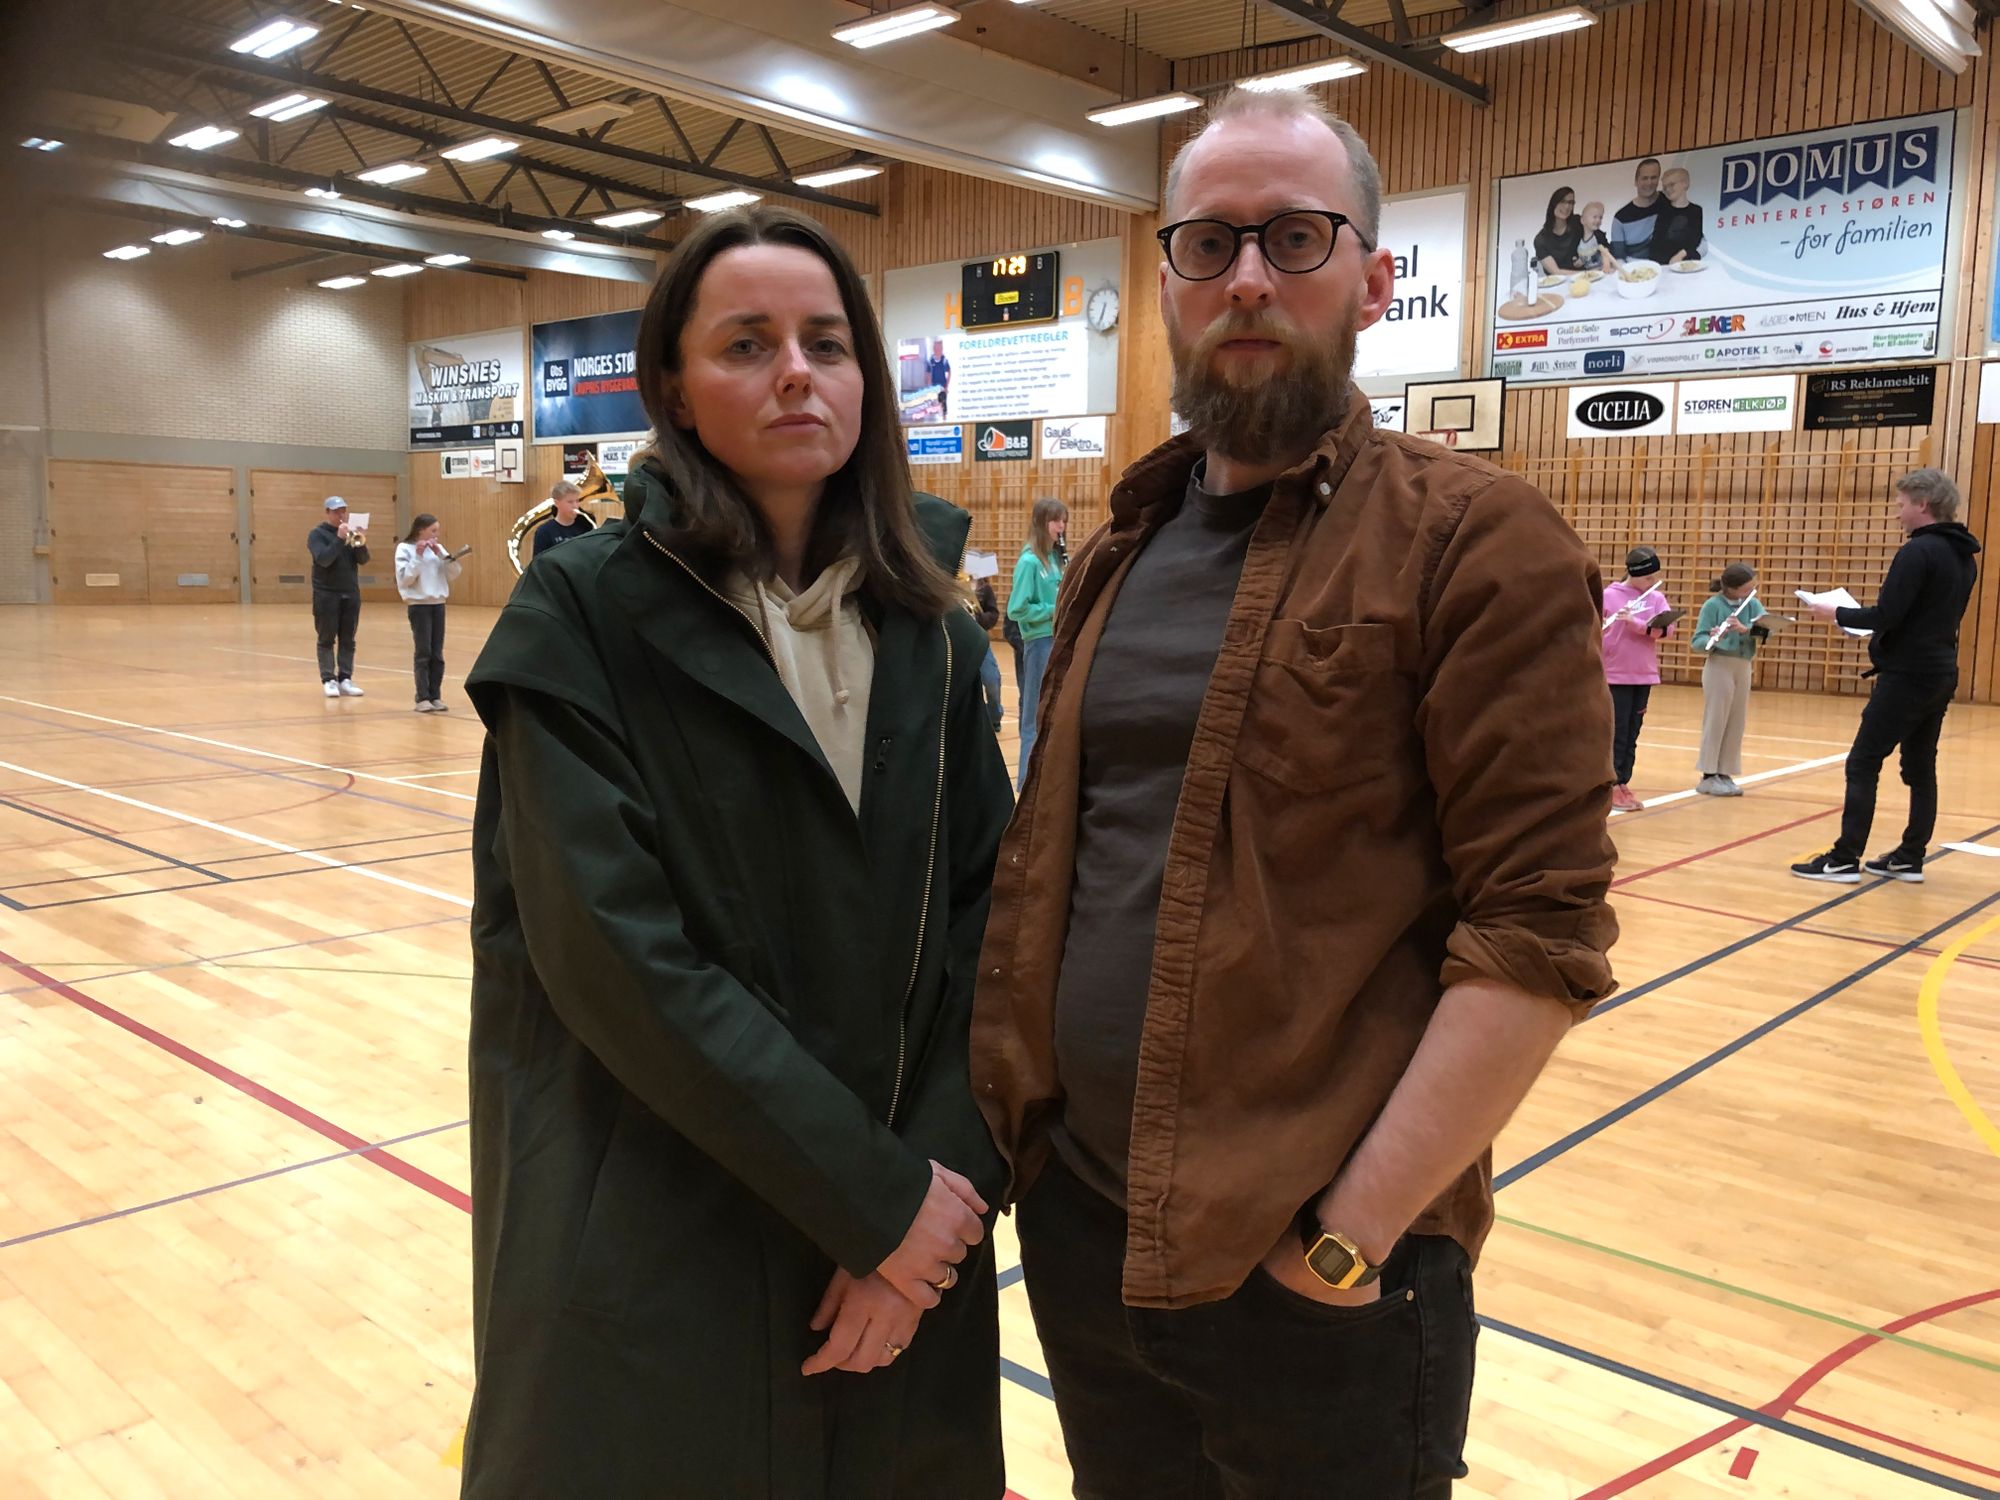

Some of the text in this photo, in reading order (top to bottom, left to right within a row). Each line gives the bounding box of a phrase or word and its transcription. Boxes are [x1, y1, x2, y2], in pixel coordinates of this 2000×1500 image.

[1723, 133, 1928, 194] DOMUS
[1717, 191, 1935, 229] SENTERET STØREN
[1794, 224, 1832, 259] for
[1836, 215, 1933, 255] familien
[1063, 275, 1084, 317] B
[1836, 300, 1936, 320] Hus & Hjem
[1610, 323, 1653, 337] sport
[1688, 314, 1746, 336] LEKER
[959, 330, 1069, 350] FORELDREVETTREGLER
[1515, 334, 1545, 345] EXTRA
[1716, 345, 1769, 357] APOTEK 1
[573, 354, 613, 377] NORGES
[1588, 354, 1621, 369] norli
[431, 358, 501, 388] WINSNES
[1831, 374, 1930, 391] RS Reklameskilt
[415, 391, 450, 406] MASKIN
[460, 383, 519, 402] TRANSPORT
[546, 378, 568, 392] BYGG
[1587, 399, 1651, 422] CICELIA
[1684, 399, 1732, 412] STØREN
[1006, 436, 1028, 449] B&B
[1059, 438, 1092, 450] Elektro
